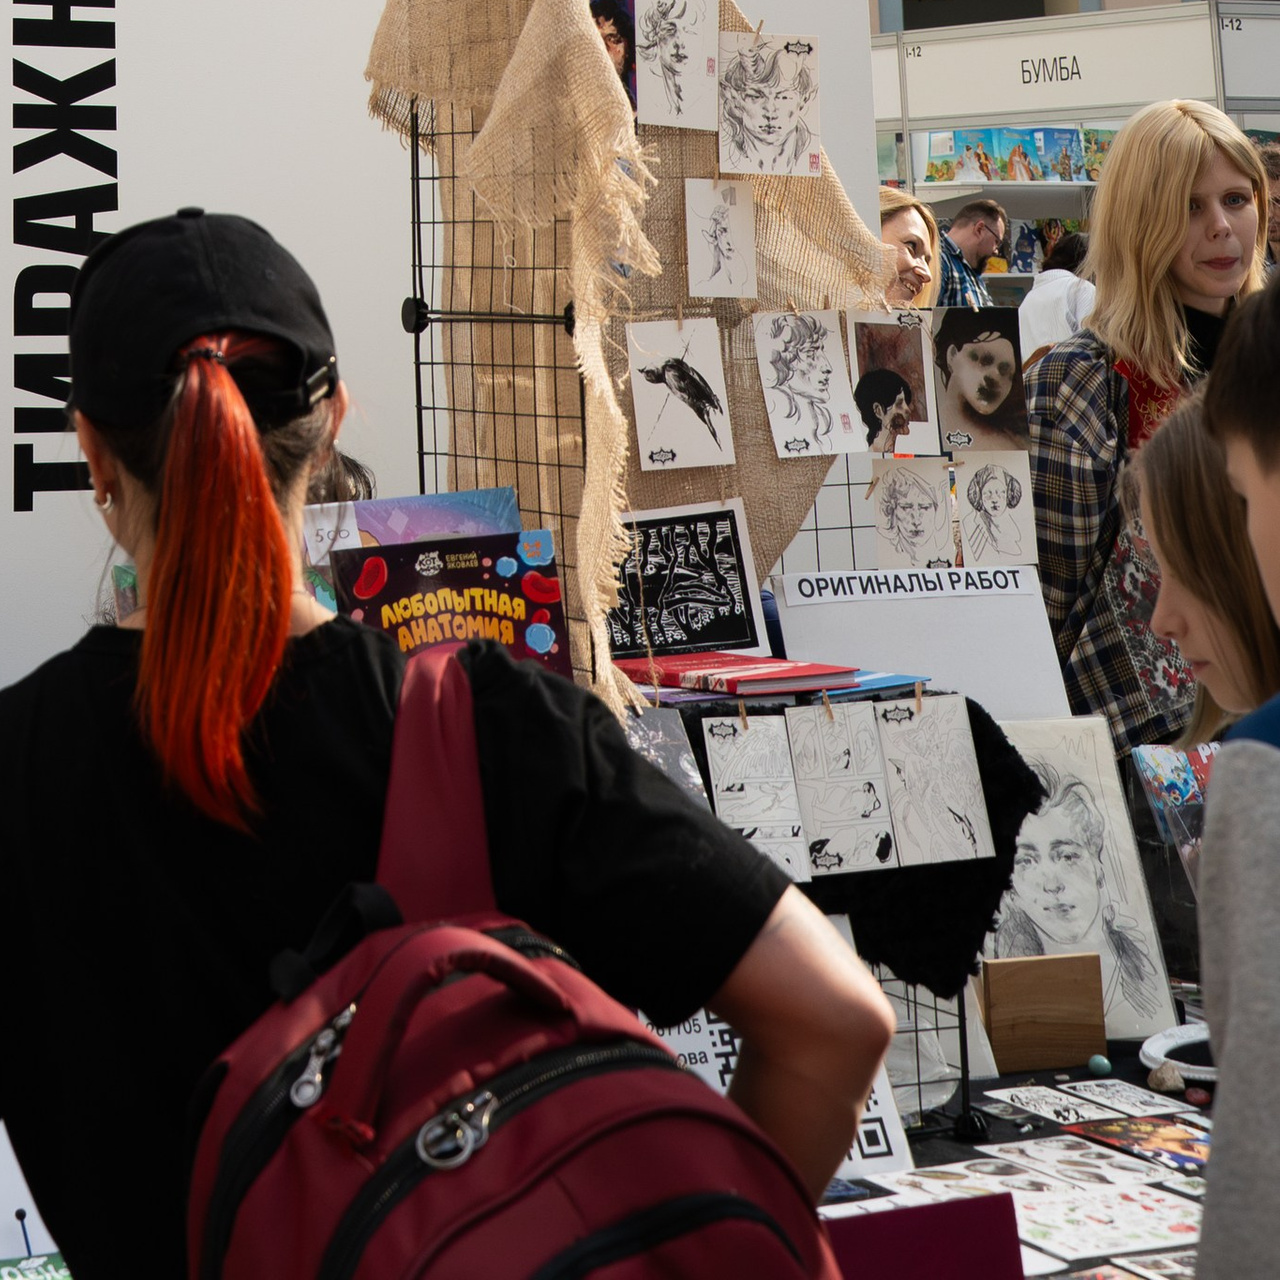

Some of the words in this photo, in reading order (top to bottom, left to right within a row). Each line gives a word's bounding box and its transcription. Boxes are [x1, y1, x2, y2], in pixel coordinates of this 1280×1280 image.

[1221, 18, 1243, 31] I-12
[905, 45, 923, 59] I-12
[1020, 55, 1082, 85] БУМБА
[314, 527, 351, 543] 500
[797, 572, 944, 599] ОРИГИНАЛЫ
[948, 569, 1021, 592] РАБОТ
[381, 586, 527, 630] ЛЮБОПЫТНАЯ
[397, 614, 515, 653] АНАТОМИЯ
